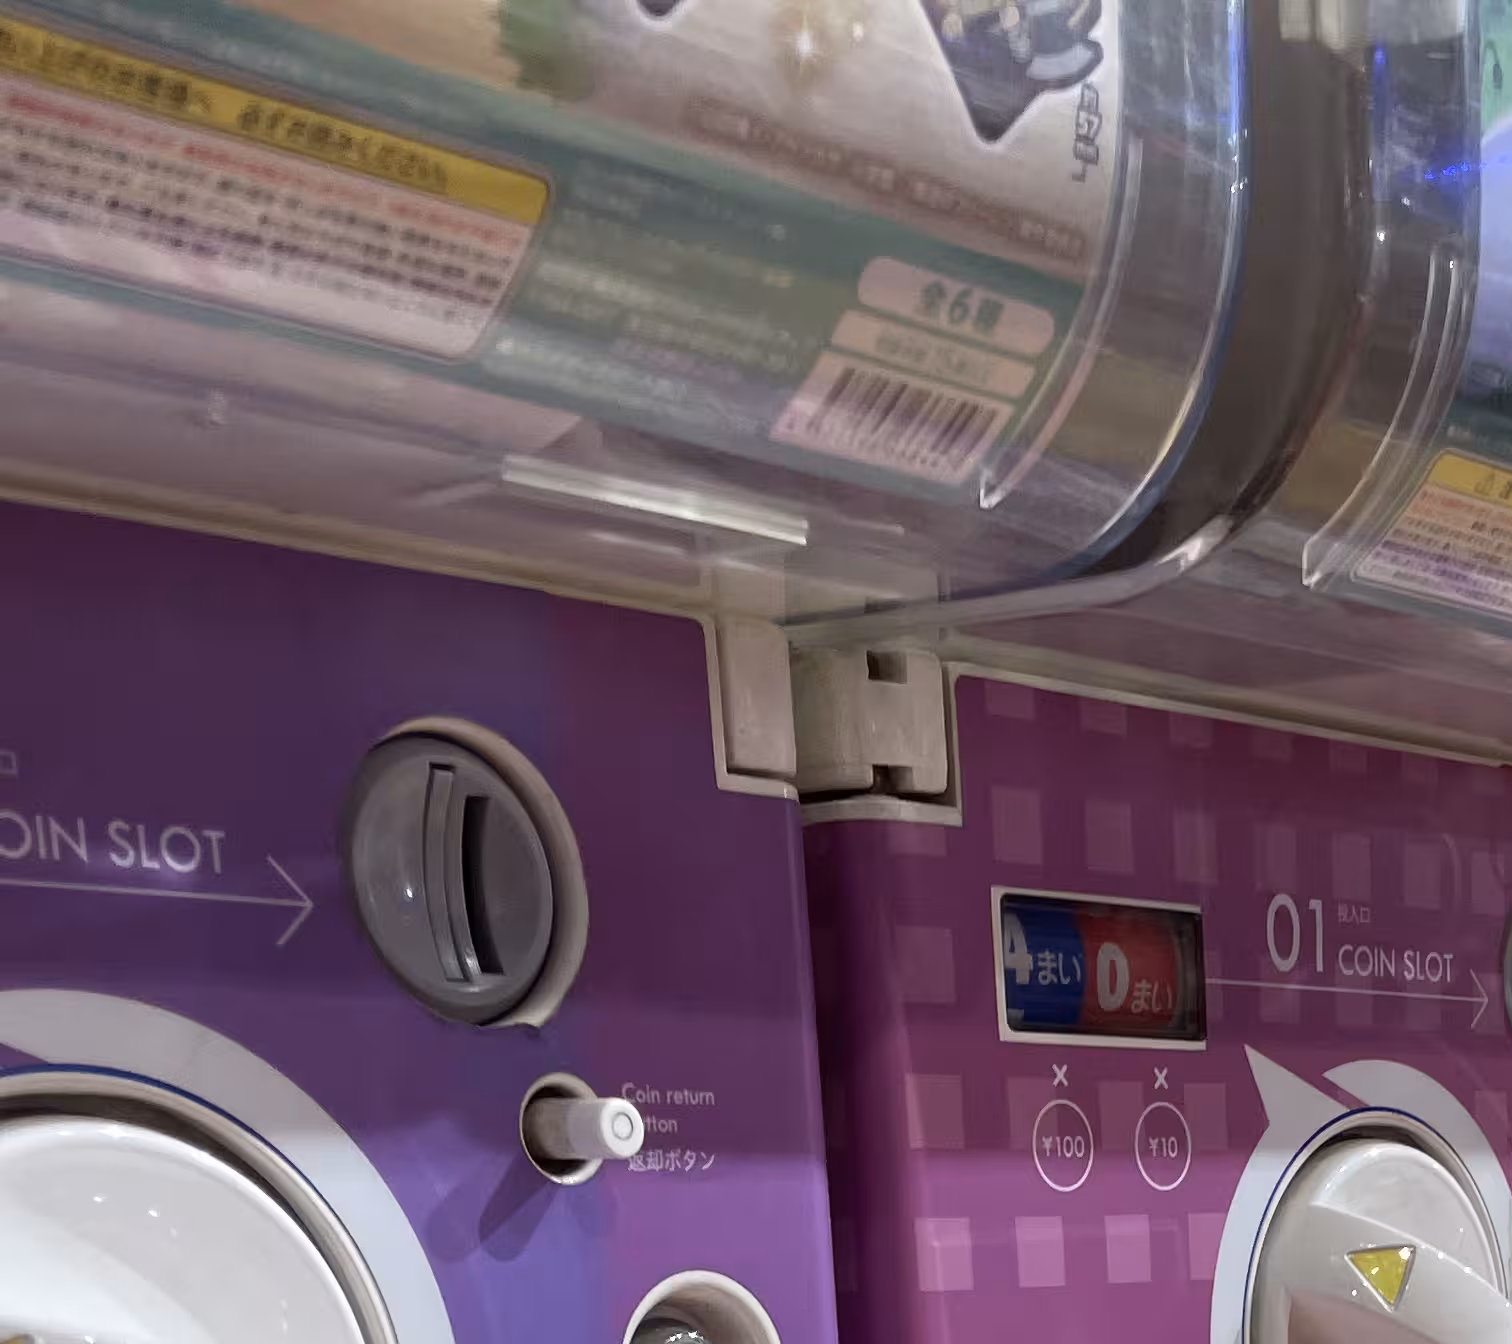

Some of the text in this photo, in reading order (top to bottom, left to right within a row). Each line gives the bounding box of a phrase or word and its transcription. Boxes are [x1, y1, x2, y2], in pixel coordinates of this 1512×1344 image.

[0, 810, 225, 876] OIN SLOT
[1267, 894, 1324, 973] 01
[1338, 944, 1454, 983] COIN SLOT
[621, 1081, 715, 1107] Coin return
[642, 1112, 678, 1133] tton
[1041, 1133, 1085, 1159] ¥100
[1148, 1134, 1178, 1160] ¥10
